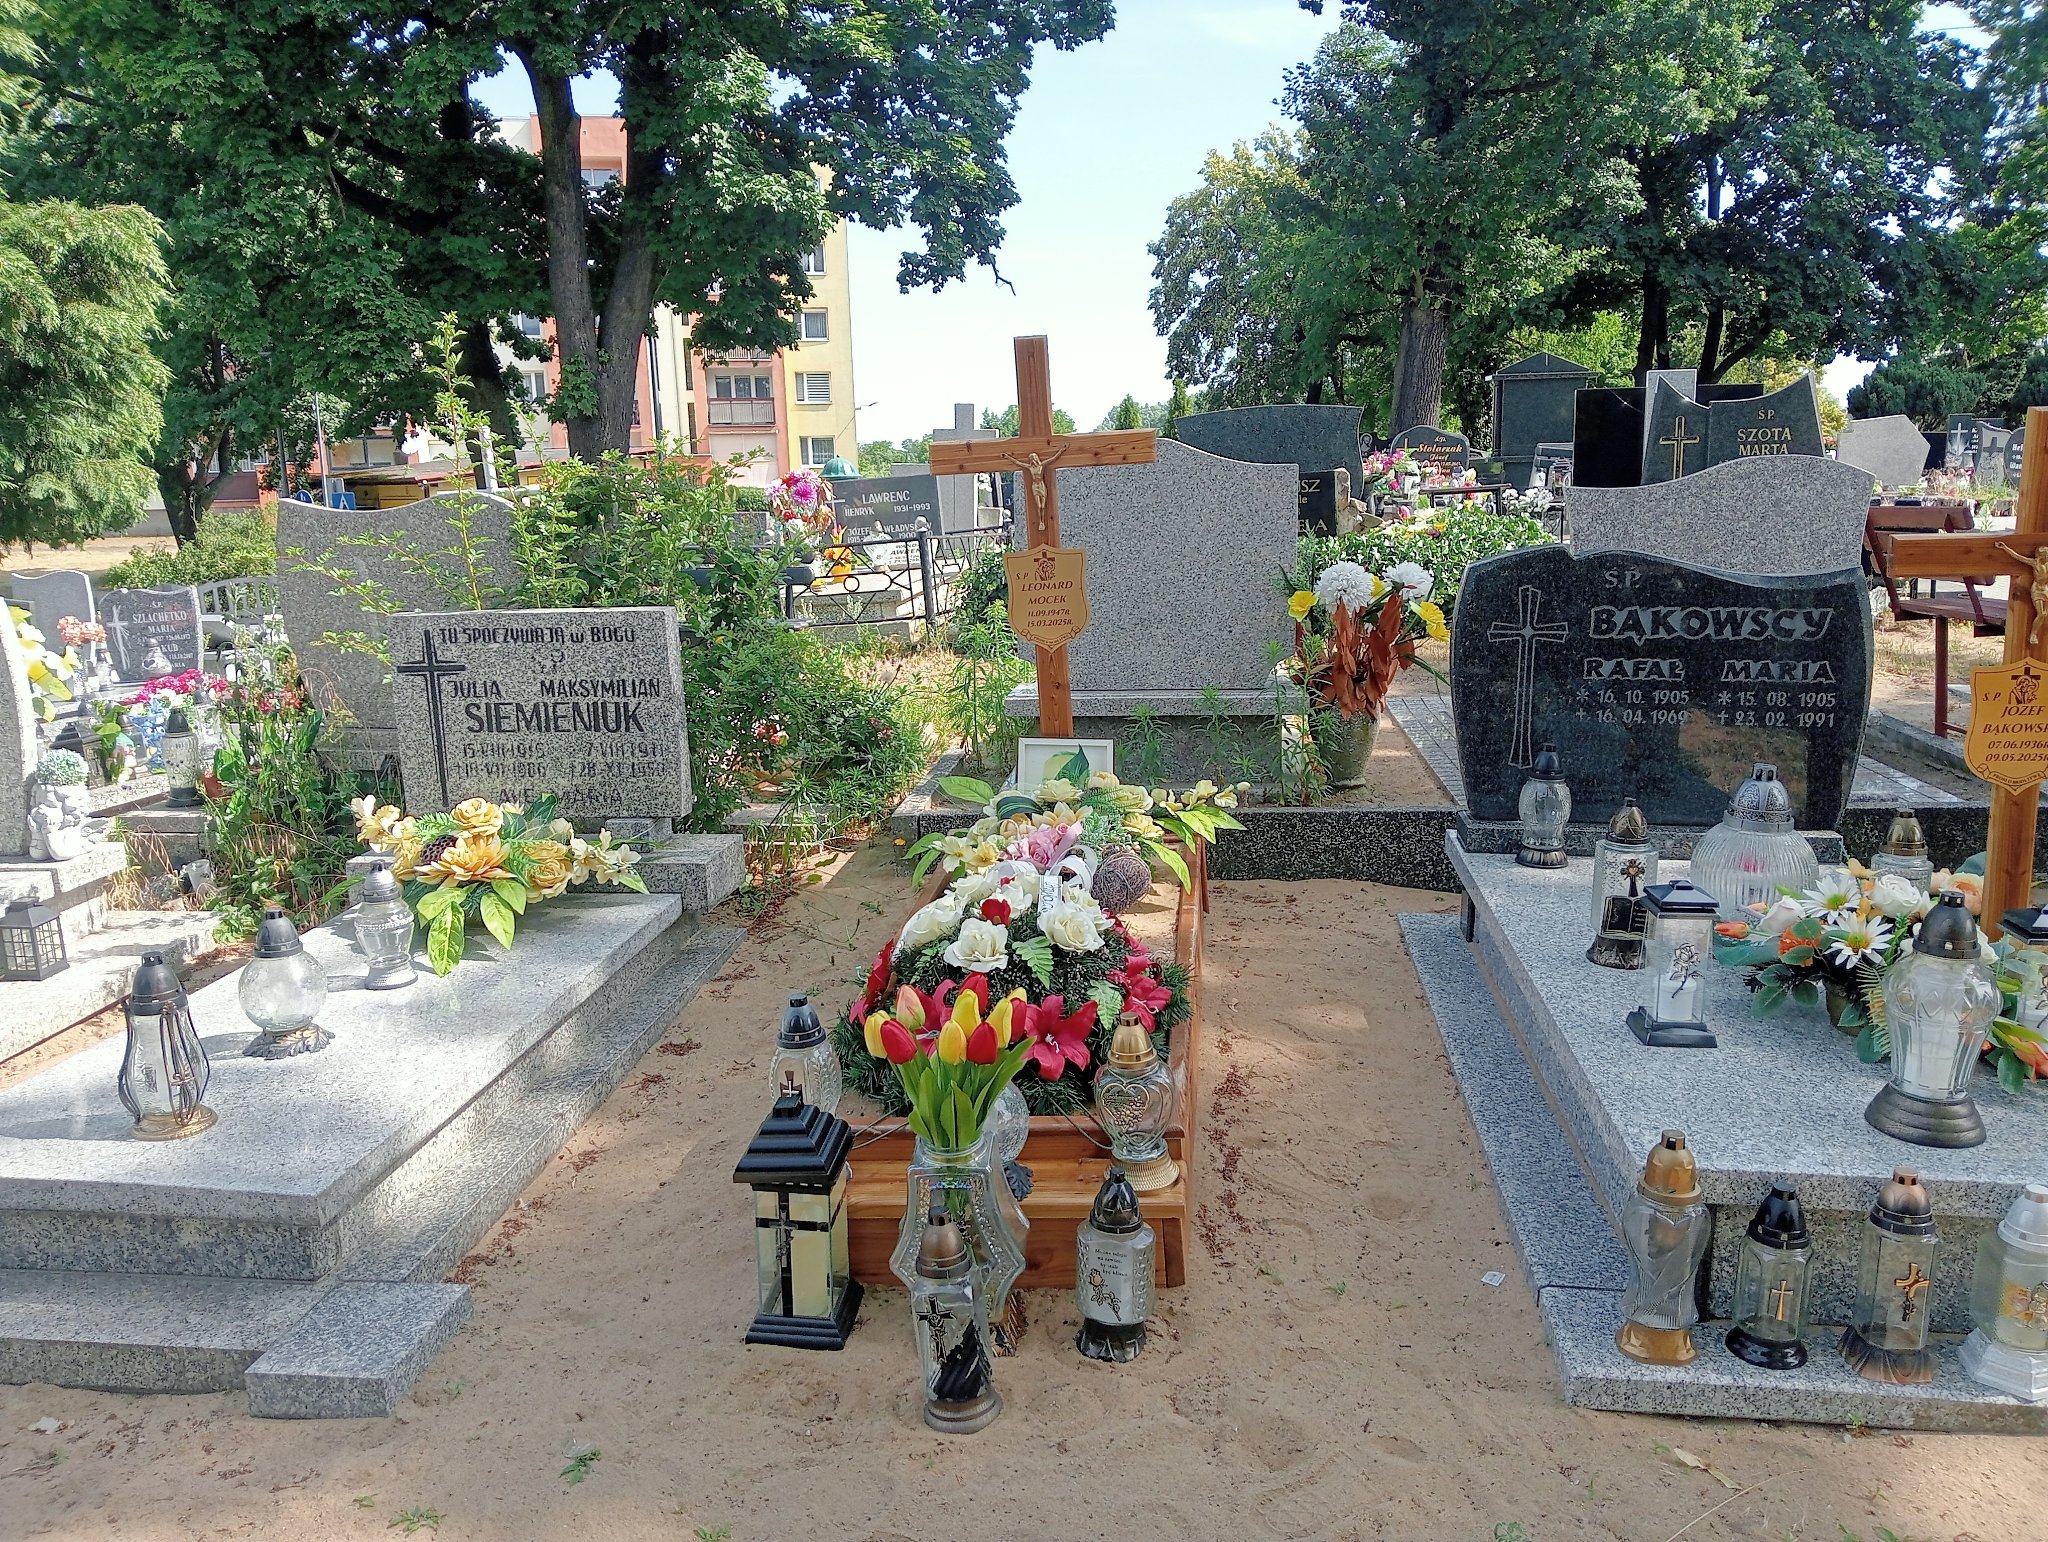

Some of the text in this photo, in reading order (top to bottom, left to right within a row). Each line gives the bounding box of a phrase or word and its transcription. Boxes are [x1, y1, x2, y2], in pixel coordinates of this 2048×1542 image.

[1737, 427, 1792, 441] SZOTA
[1417, 443, 1463, 453] Stolarzak
[1739, 443, 1789, 456] MARTA
[1298, 479, 1321, 493] SZ
[862, 490, 911, 505] LAWRENC
[844, 506, 875, 517] HENRYK
[893, 503, 931, 513] 1931-1993
[847, 526, 873, 537] JÓZEF
[1021, 580, 1074, 592] LEONARD
[1027, 595, 1068, 605] MOCEK
[132, 610, 187, 624] SZLACHETKO
[148, 624, 176, 634] MARIA
[1589, 604, 1835, 647] BĄKOWSCY
[440, 627, 458, 644] TU
[590, 625, 636, 643] BOGU
[1582, 657, 1836, 683] RAFAŁ MARIA
[449, 678, 661, 699] JULIA MAKSYMILIAN
[1626, 690, 1646, 704] 10.
[1652, 690, 1690, 705] 1905
[1766, 692, 1791, 706] 08.
[1799, 692, 1836, 707] 1905
[464, 702, 645, 734] SIEMIENIUK
[1622, 710, 1647, 725] 04.
[1651, 710, 1689, 725] 1969
[1765, 712, 1789, 727] 02.
[1798, 712, 1835, 728] 1991
